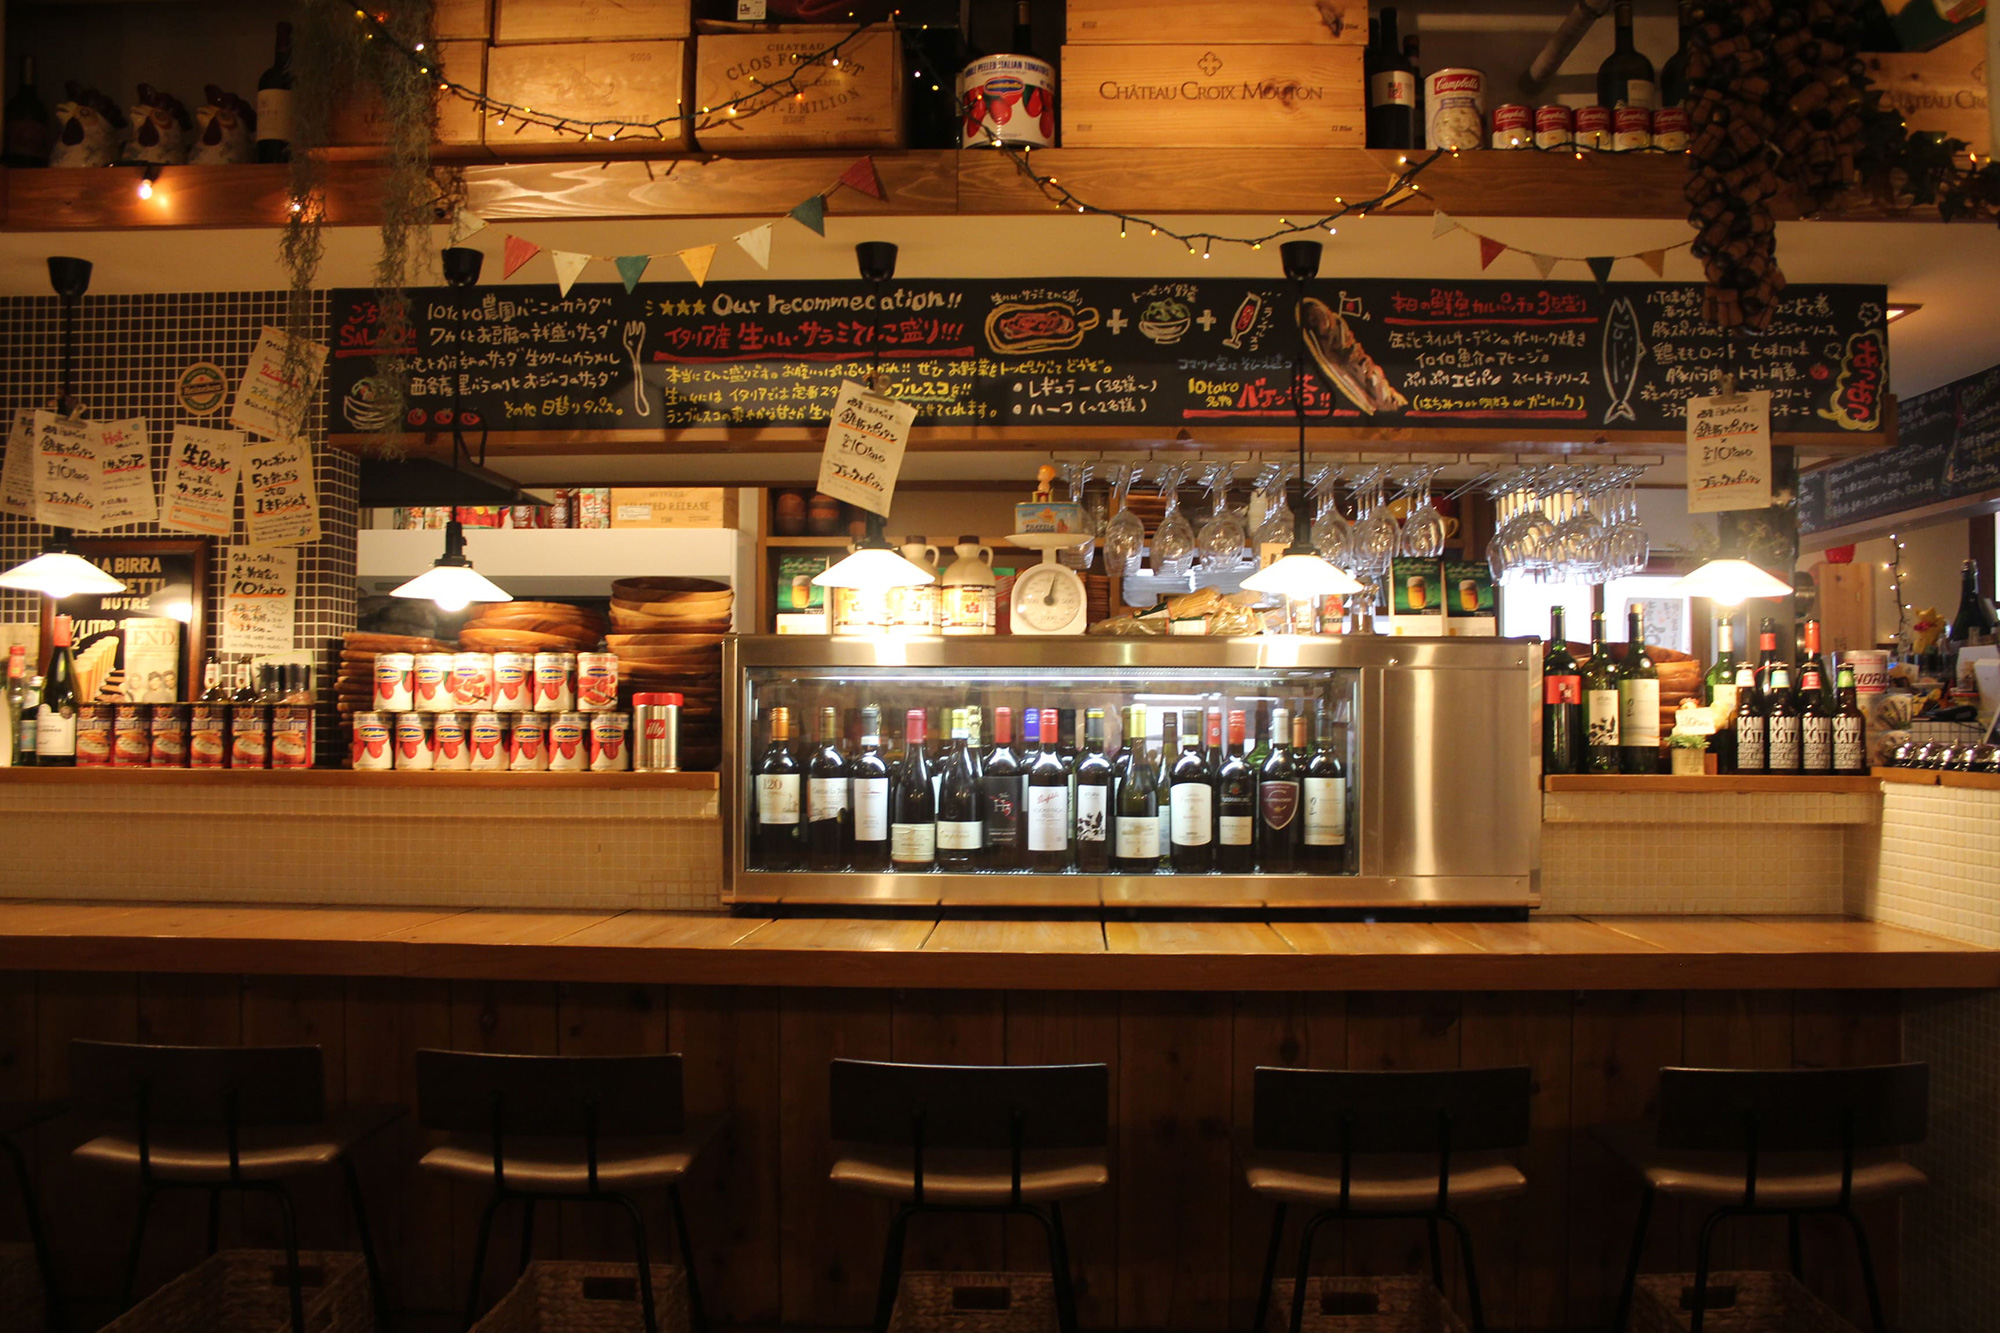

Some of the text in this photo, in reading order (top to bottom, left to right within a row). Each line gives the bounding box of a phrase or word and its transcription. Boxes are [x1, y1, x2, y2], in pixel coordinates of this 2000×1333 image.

[726, 52, 865, 81] CLOS FOURET
[1180, 81, 1234, 101] CROIX
[712, 292, 760, 316] Our
[668, 501, 711, 511] RELEASE
[114, 556, 162, 573] BIRRA
[100, 597, 151, 610] NUTRE
[645, 721, 665, 739] illy
[762, 777, 783, 790] 120
